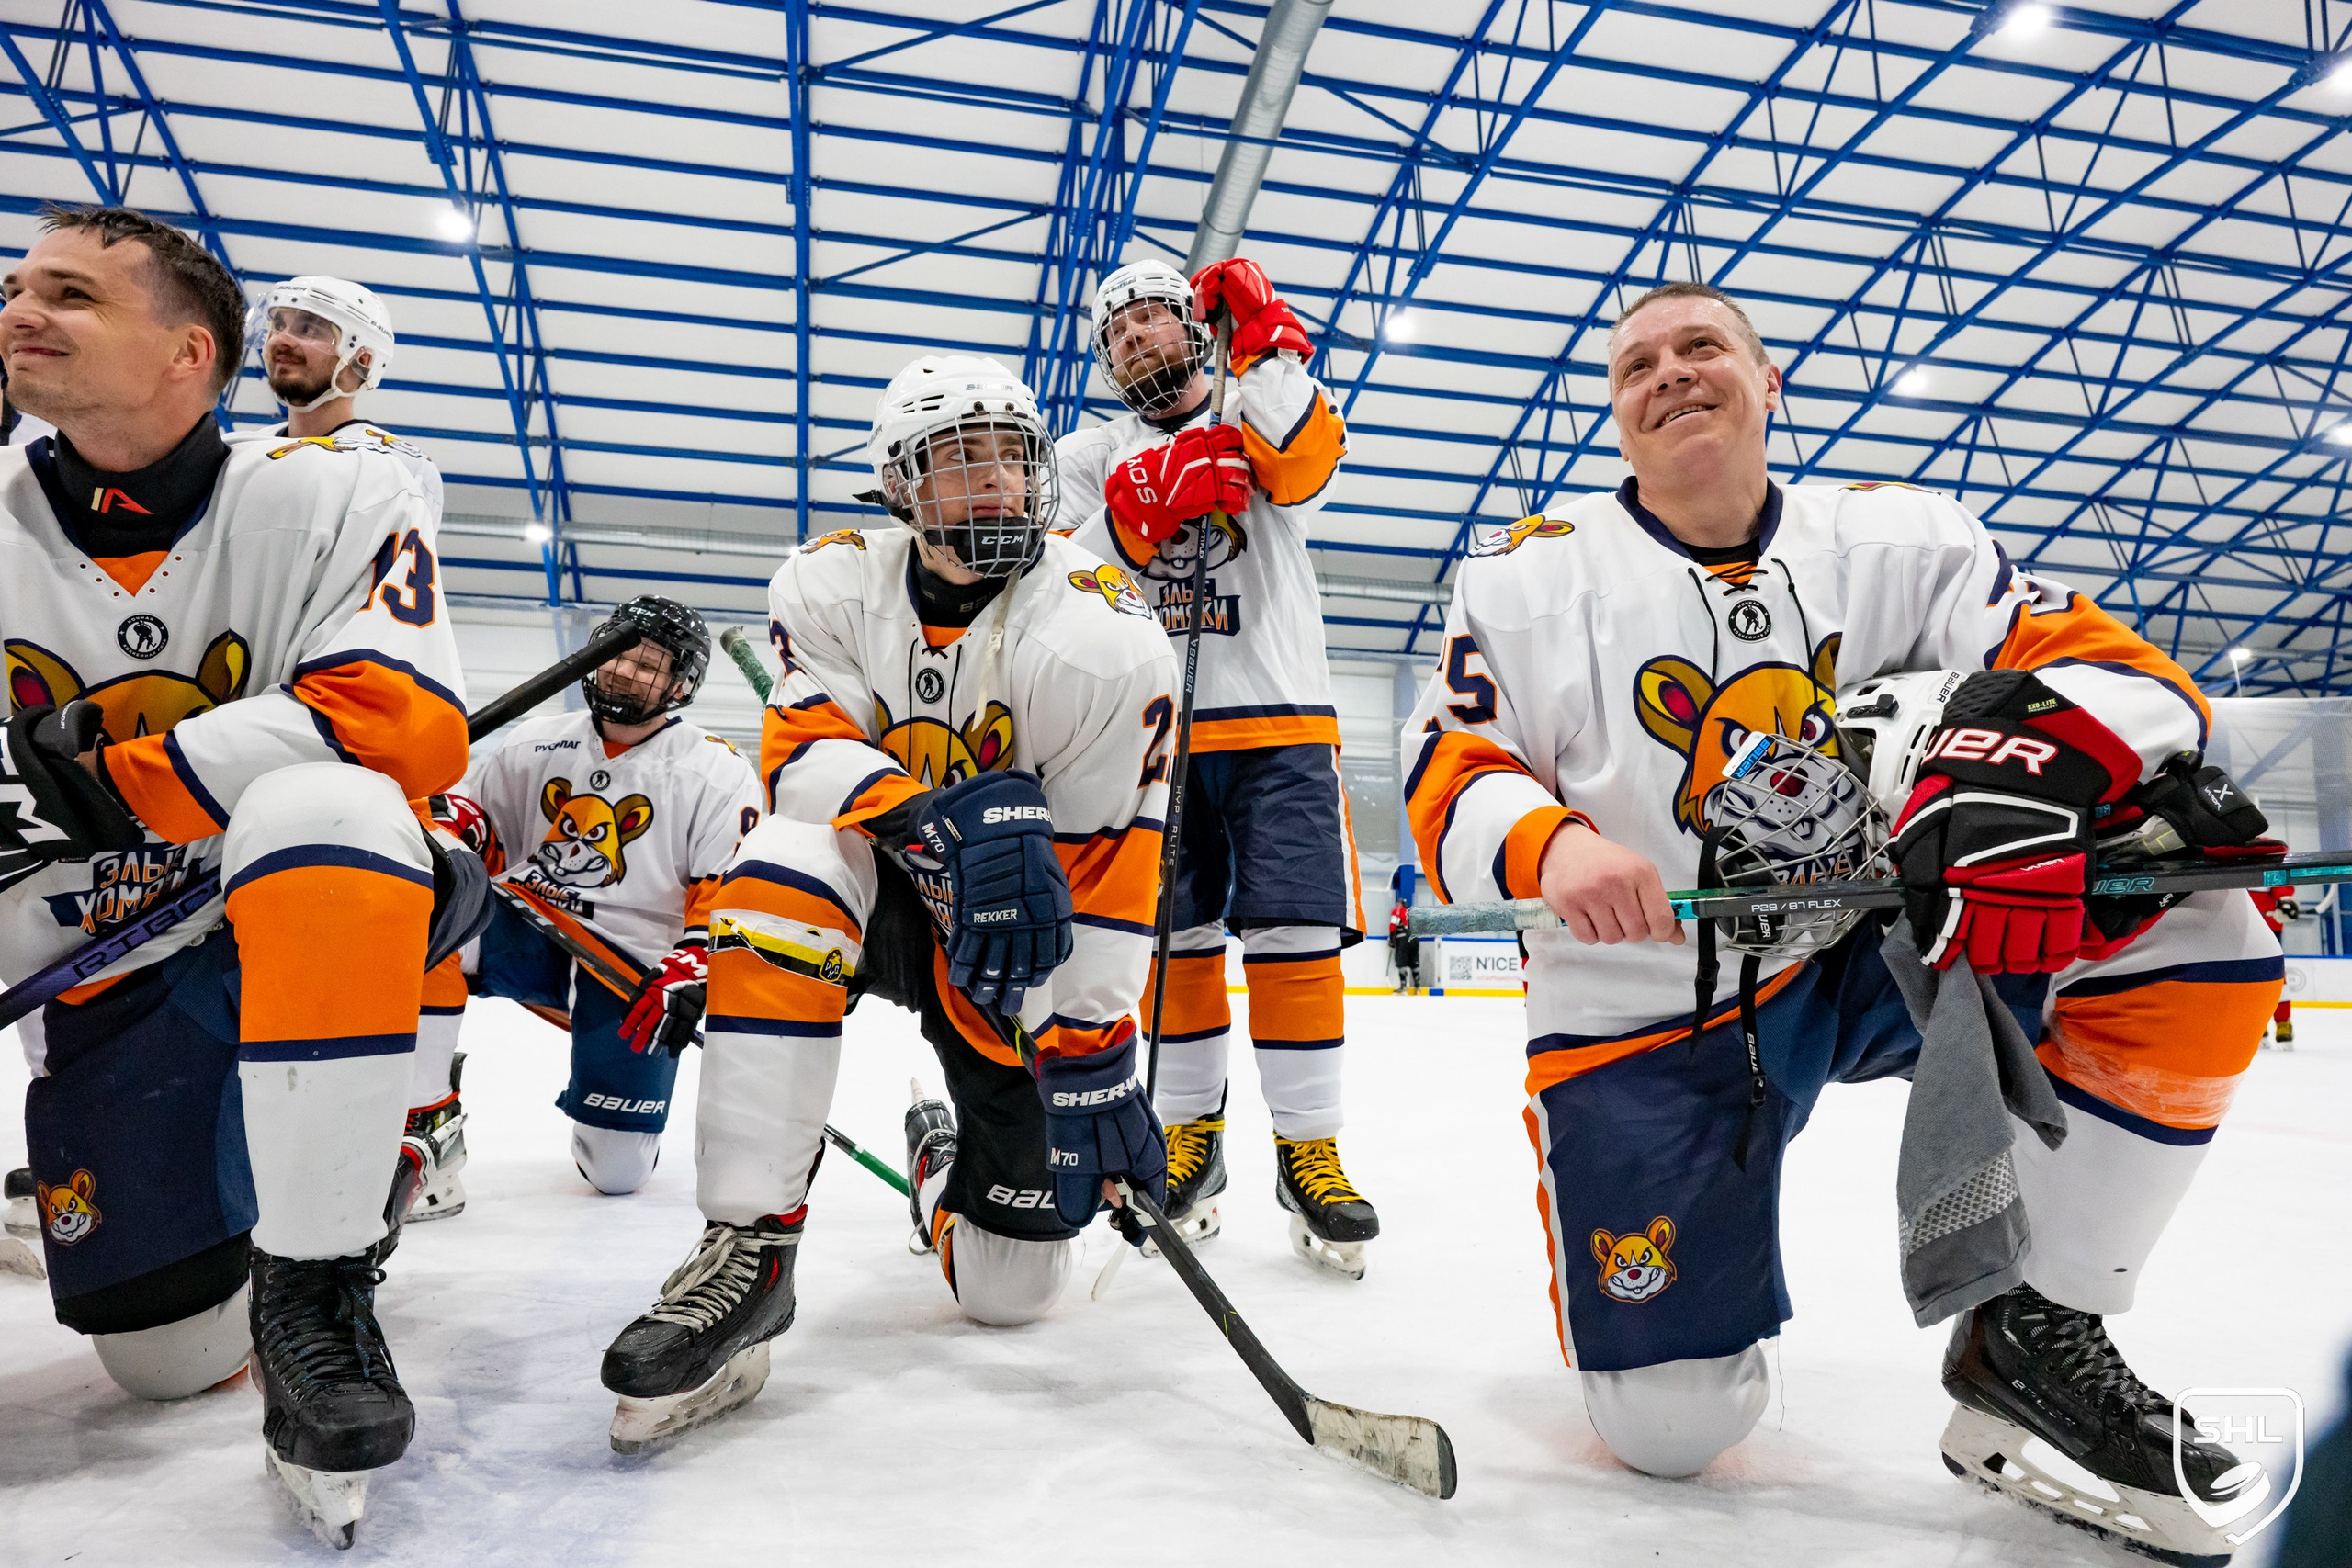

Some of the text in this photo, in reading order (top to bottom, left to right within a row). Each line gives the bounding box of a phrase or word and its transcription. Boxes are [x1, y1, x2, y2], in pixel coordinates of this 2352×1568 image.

[981, 536, 1024, 545] CCM
[356, 527, 435, 629] 13
[1186, 647, 1196, 694] BAUER
[1422, 634, 1497, 732] 5
[1937, 671, 1961, 703] BAUER
[1136, 694, 1174, 790] 2
[1734, 739, 1771, 778] BAUER
[922, 821, 945, 853] M70
[973, 908, 1018, 923] REKKER
[1751, 901, 1779, 912] P28
[1808, 898, 1842, 909] FLEX
[583, 1092, 666, 1114] BAUER
[1050, 1147, 1079, 1167] M70
